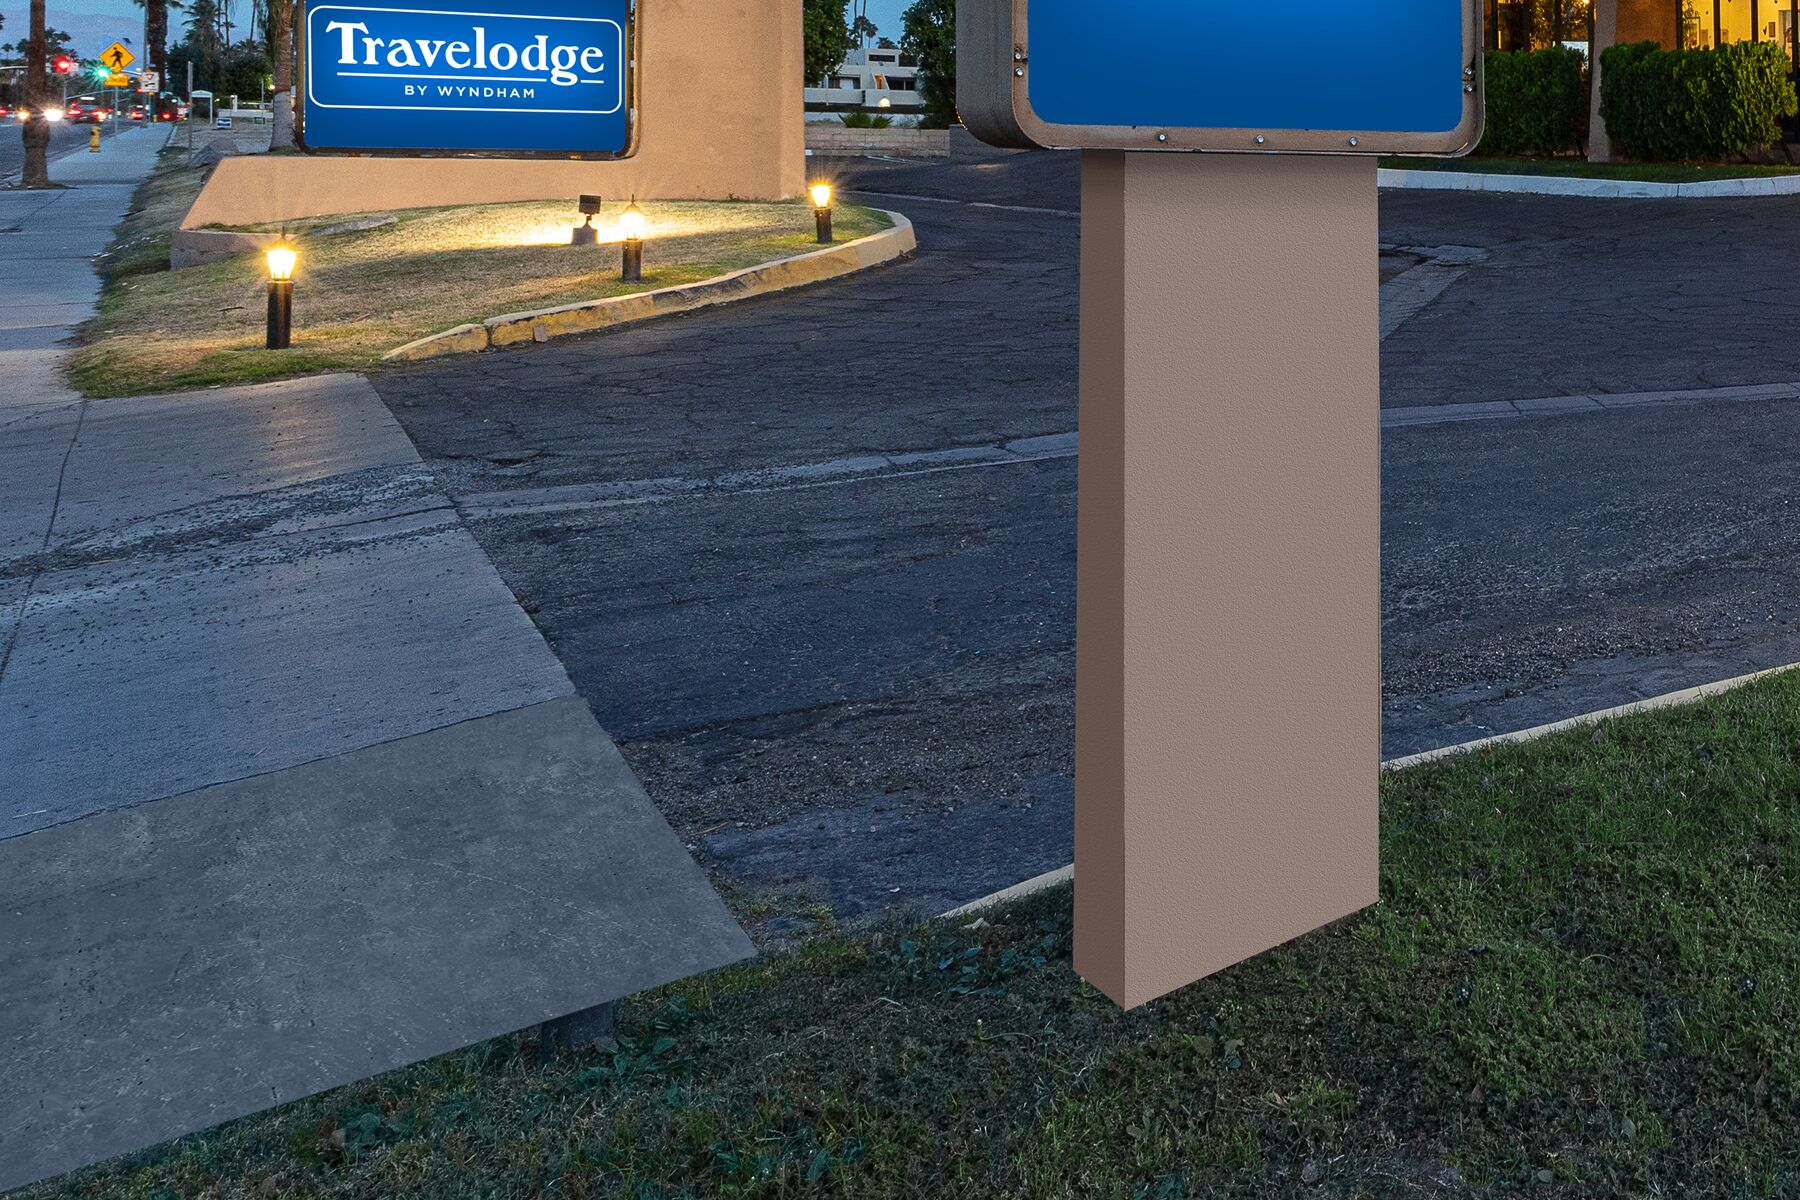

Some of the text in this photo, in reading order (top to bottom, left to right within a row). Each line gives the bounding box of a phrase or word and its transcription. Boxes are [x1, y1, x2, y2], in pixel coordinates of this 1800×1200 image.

[326, 21, 604, 87] Travelodge
[405, 85, 535, 98] BY WYNDHAM
